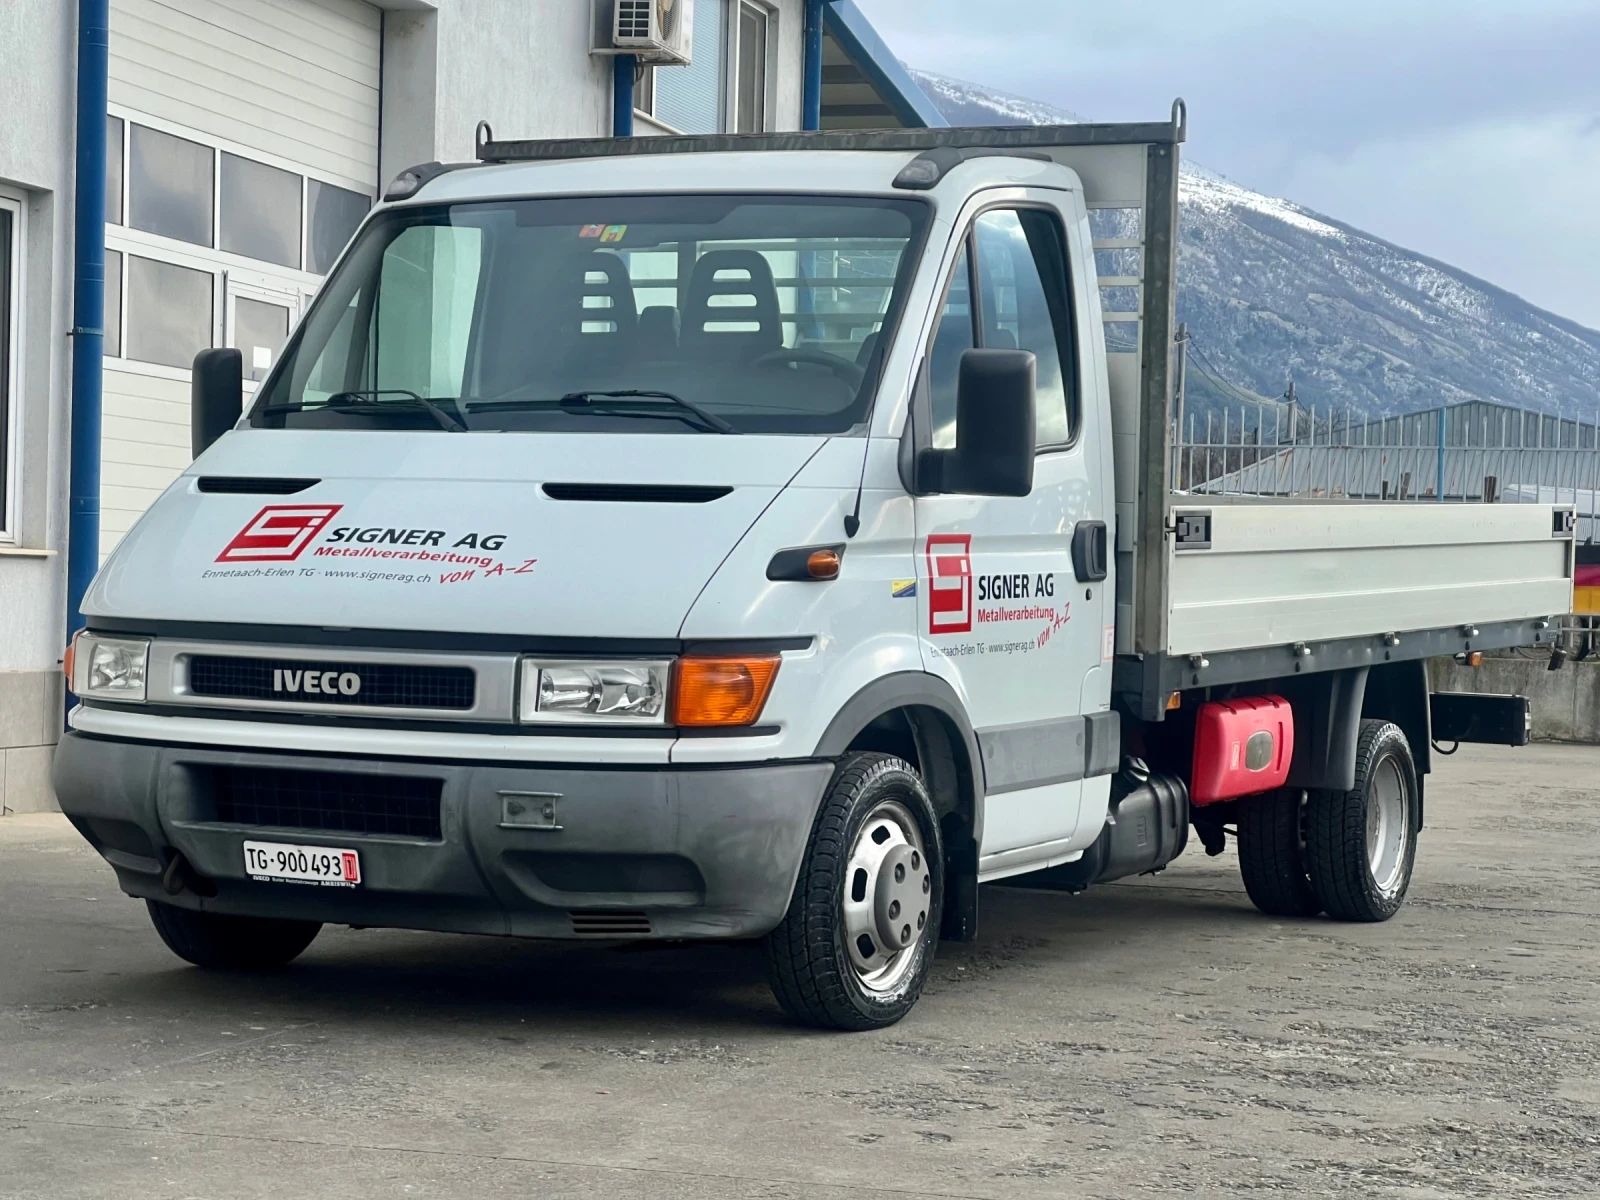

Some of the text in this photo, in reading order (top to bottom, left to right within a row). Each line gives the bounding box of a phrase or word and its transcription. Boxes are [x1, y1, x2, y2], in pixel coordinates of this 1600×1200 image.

[326, 527, 508, 551] SIGNER AG
[313, 546, 494, 568] Metallverarbeitung
[202, 567, 432, 584] Ennetaach-Erlen TG www.signerag.ch
[484, 559, 538, 578] A-Z
[978, 573, 1054, 601] SIGNER AG
[977, 605, 1055, 622] Metallverarbeitung
[977, 643, 985, 654] TG
[988, 639, 1035, 655] www.signerag.ch
[273, 669, 361, 696] IVECO
